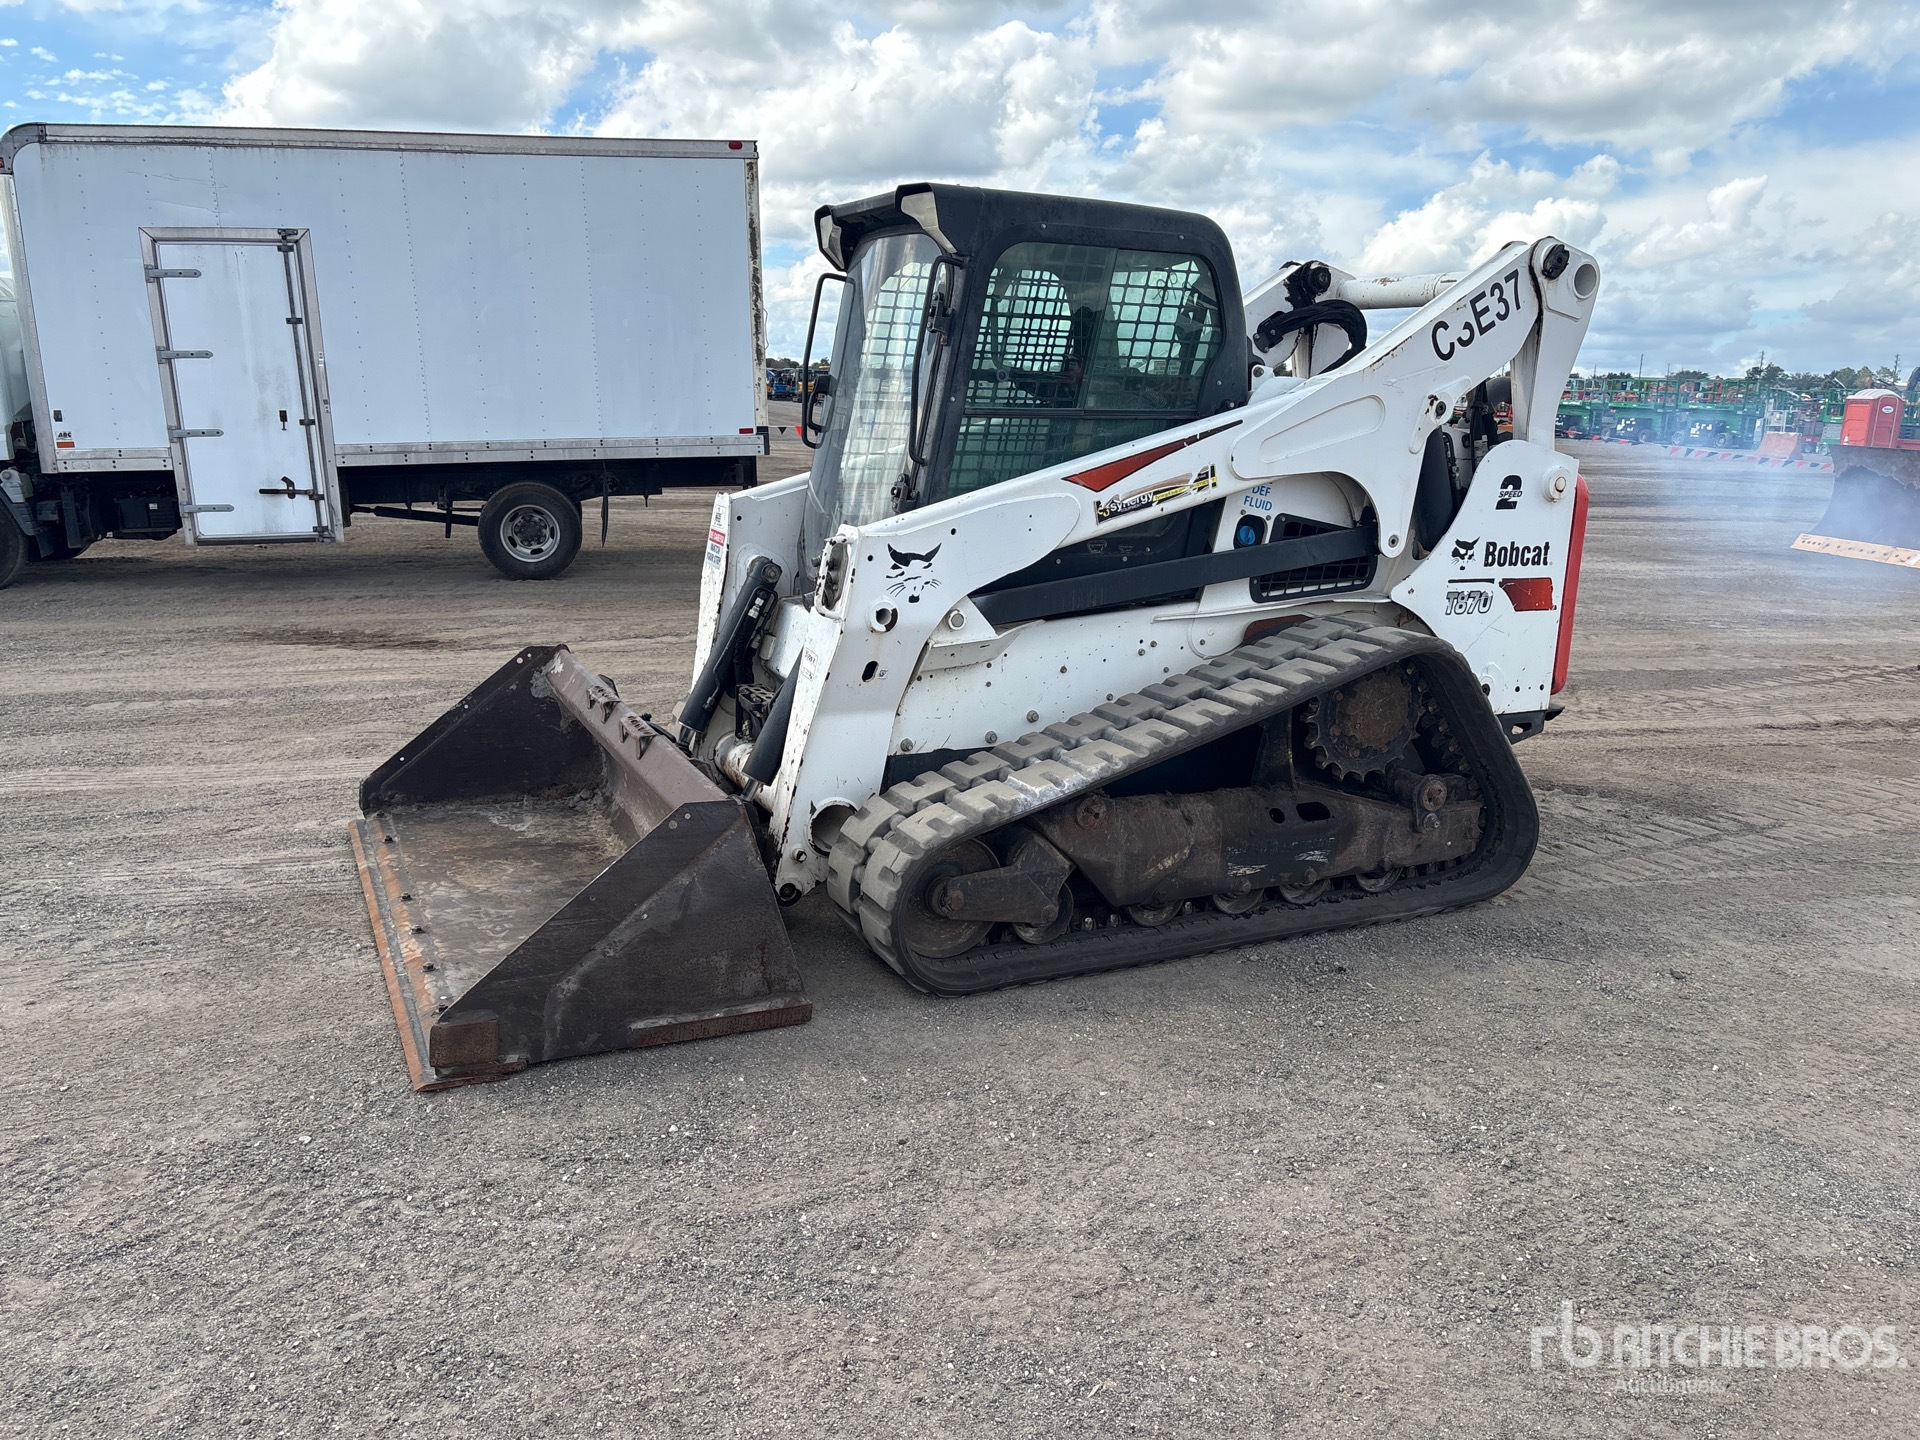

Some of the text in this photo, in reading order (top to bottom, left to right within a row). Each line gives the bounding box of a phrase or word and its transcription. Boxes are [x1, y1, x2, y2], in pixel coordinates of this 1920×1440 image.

[1252, 485, 1271, 496] DEF
[1495, 475, 1522, 510] 2
[1498, 490, 1523, 498] SPEED
[1243, 495, 1273, 511] FLUID
[1484, 541, 1550, 567] Bobcat
[1445, 590, 1493, 615] T870
